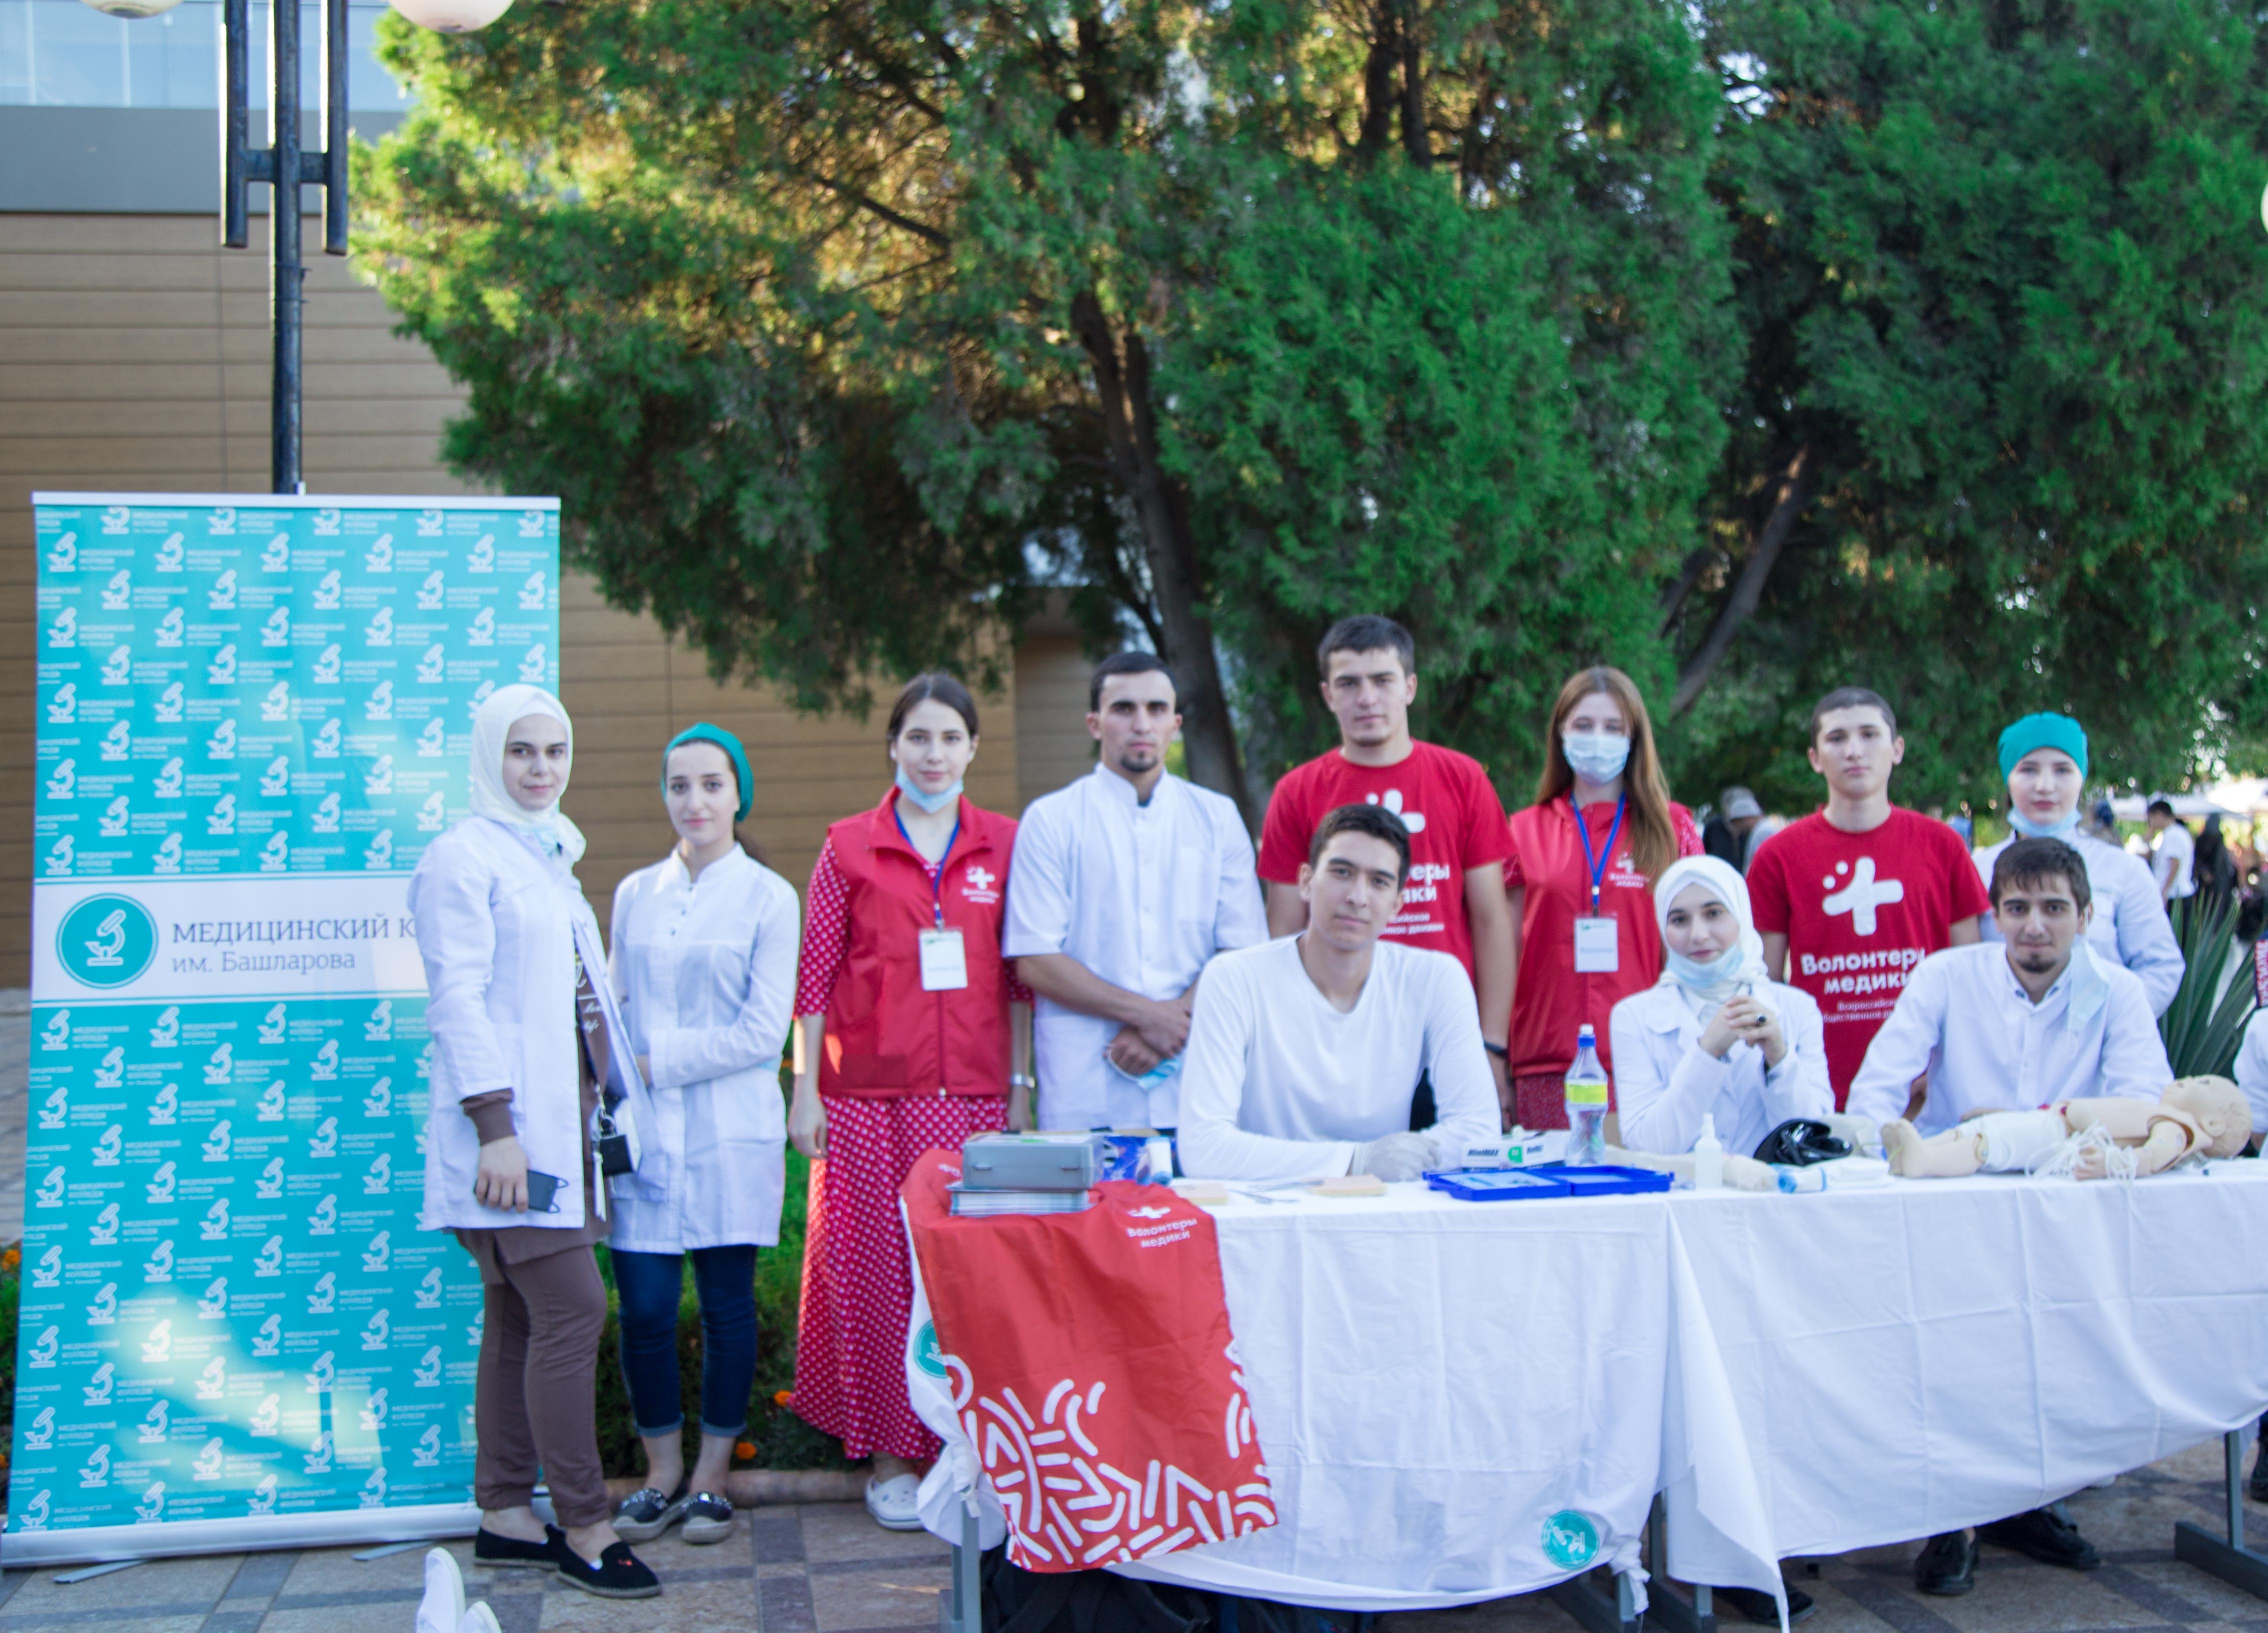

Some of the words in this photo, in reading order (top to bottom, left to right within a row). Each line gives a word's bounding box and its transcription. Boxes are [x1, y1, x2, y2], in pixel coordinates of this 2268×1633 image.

[173, 912, 390, 946] МЕДИЦИНСКИЙ
[399, 919, 416, 938] К
[172, 956, 213, 973] им.
[221, 951, 356, 975] Башларова
[1127, 1219, 1198, 1237] Волонтеры
[1142, 1230, 1190, 1248] медики
